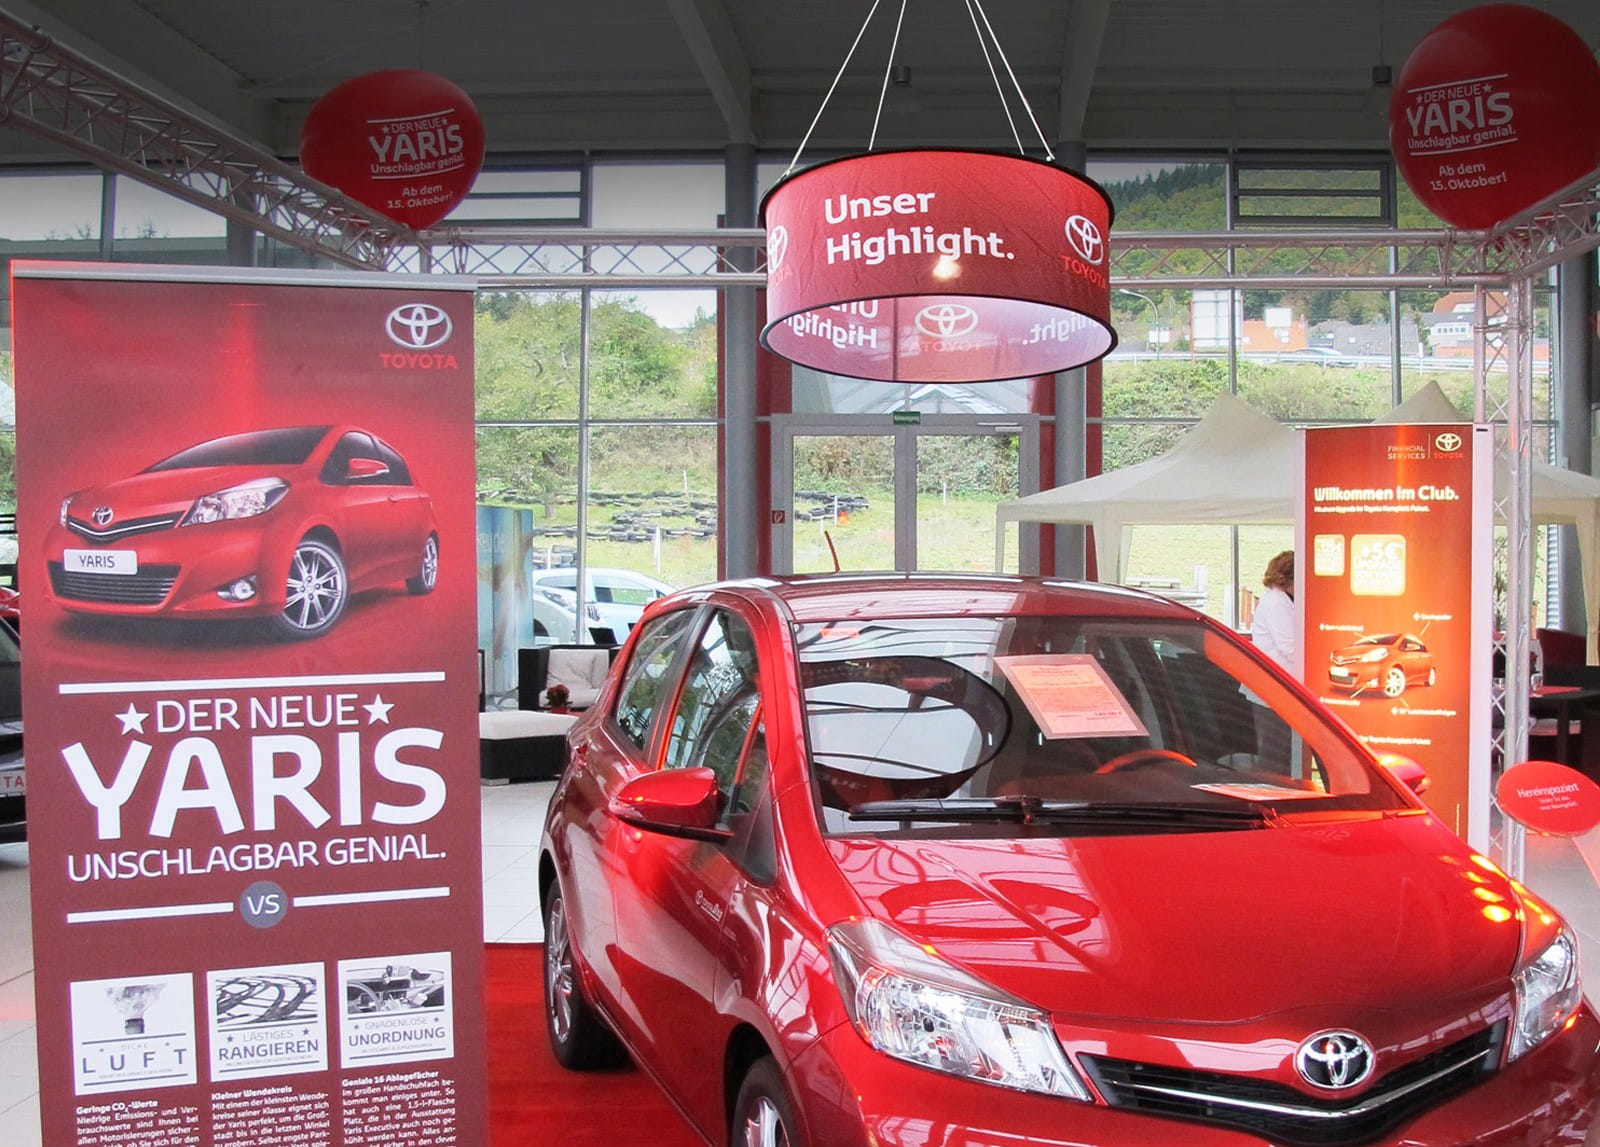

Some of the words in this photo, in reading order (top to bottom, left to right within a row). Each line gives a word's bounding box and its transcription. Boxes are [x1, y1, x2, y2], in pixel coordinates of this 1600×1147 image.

[1423, 90, 1446, 103] DER
[1448, 83, 1481, 99] NEUE
[1406, 92, 1514, 137] YARIS
[391, 121, 414, 133] DER
[416, 117, 442, 131] NEUE
[369, 124, 464, 163] YARIS
[1408, 133, 1471, 149] Unschlagbar
[1473, 124, 1517, 144] genial.
[371, 161, 436, 174] Unschlagbar
[1439, 165, 1455, 177] Ab
[1457, 162, 1486, 175] dem
[1430, 180, 1447, 191] 15.
[1448, 171, 1507, 190] Oktober!
[402, 186, 418, 197] Ab
[420, 184, 443, 195] dem
[387, 199, 404, 209] 15.
[407, 191, 453, 208] Oktober!
[825, 193, 935, 225] Unser
[826, 226, 1015, 266] Highlight.
[379, 353, 458, 369] TOYOTA
[1314, 487, 1393, 502] Willkommen
[1396, 485, 1415, 500] im
[1418, 485, 1459, 501] Club.
[79, 555, 115, 568] YARIS
[156, 698, 240, 733] DER
[250, 693, 359, 729] NEUE
[61, 727, 447, 840] YARIS
[68, 841, 319, 882] UNSCHLAGBAR
[325, 833, 447, 865] GENIAL.
[246, 894, 281, 915] VS
[365, 1017, 428, 1030] GNADENLOSE
[349, 1027, 445, 1046] UNORDNUNG
[121, 1042, 149, 1051] DICKE
[219, 1040, 319, 1060] RANGIEREN
[342, 1077, 373, 1087] Geniale
[374, 1076, 385, 1084] 16
[386, 1071, 439, 1082] Ablagefächer
[211, 1091, 242, 1101] Kleiner
[243, 1086, 292, 1097] Wendekreis
[343, 1098, 369, 1106] kommt
[392, 1092, 418, 1102] einiges
[421, 1090, 442, 1098] unter.
[446, 1088, 455, 1096] So
[355, 1087, 381, 1097] großen
[384, 1080, 440, 1092] Handschuhfach
[212, 1103, 224, 1111] Mit
[226, 1101, 249, 1109] einem
[251, 1099, 263, 1108] der
[264, 1095, 298, 1106] kleinsten
[299, 1092, 328, 1102] Wende-
[76, 1105, 111, 1116] Geringe
[77, 1115, 111, 1125] Niedrige
[115, 1111, 158, 1121] Emissions-
[162, 1108, 177, 1116] und
[213, 1112, 235, 1120] kreise
[237, 1110, 261, 1119] seiner
[263, 1107, 286, 1115] Klasse
[288, 1104, 312, 1113] eignet
[314, 1101, 329, 1109] sich
[343, 1108, 356, 1116] hat
[362, 1106, 379, 1114] auch
[368, 1115, 379, 1123] die
[383, 1113, 391, 1121] in
[395, 1112, 407, 1120] der
[412, 1107, 456, 1118] Ausstattung
[77, 1123, 131, 1135] brauchswerte
[136, 1120, 153, 1129] sind
[158, 1117, 181, 1126] Ihnen
[186, 1115, 199, 1123] bei
[213, 1122, 225, 1130] der
[228, 1120, 246, 1128] Yaris
[293, 1113, 305, 1122] die
[344, 1127, 362, 1135] Yaris
[364, 1123, 400, 1133] Executive
[402, 1120, 420, 1129] auch
[422, 1117, 440, 1126] noch
[443, 1117, 456, 1126] ge-
[78, 1136, 97, 1145] allen
[100, 1130, 165, 1143] Motorisierungen
[167, 1127, 191, 1138] sicher
[213, 1132, 233, 1141] stadt
[236, 1129, 247, 1138] bis
[250, 1128, 258, 1136] in
[261, 1126, 272, 1135] die
[275, 1124, 302, 1133] letzten
[304, 1120, 330, 1130] Winkel
[258, 1136, 281, 1145] Selbst
[283, 1133, 308, 1143] engste
[310, 1131, 330, 1139] Park-
[344, 1136, 364, 1144] kühlt
[367, 1133, 395, 1142] werden
[399, 1130, 419, 1138] kann.
[422, 1128, 440, 1136] Alles
[153, 1138, 169, 1147] sich
[170, 1137, 183, 1146] für
[184, 1136, 199, 1144] den
[435, 1135, 457, 1144] clever
